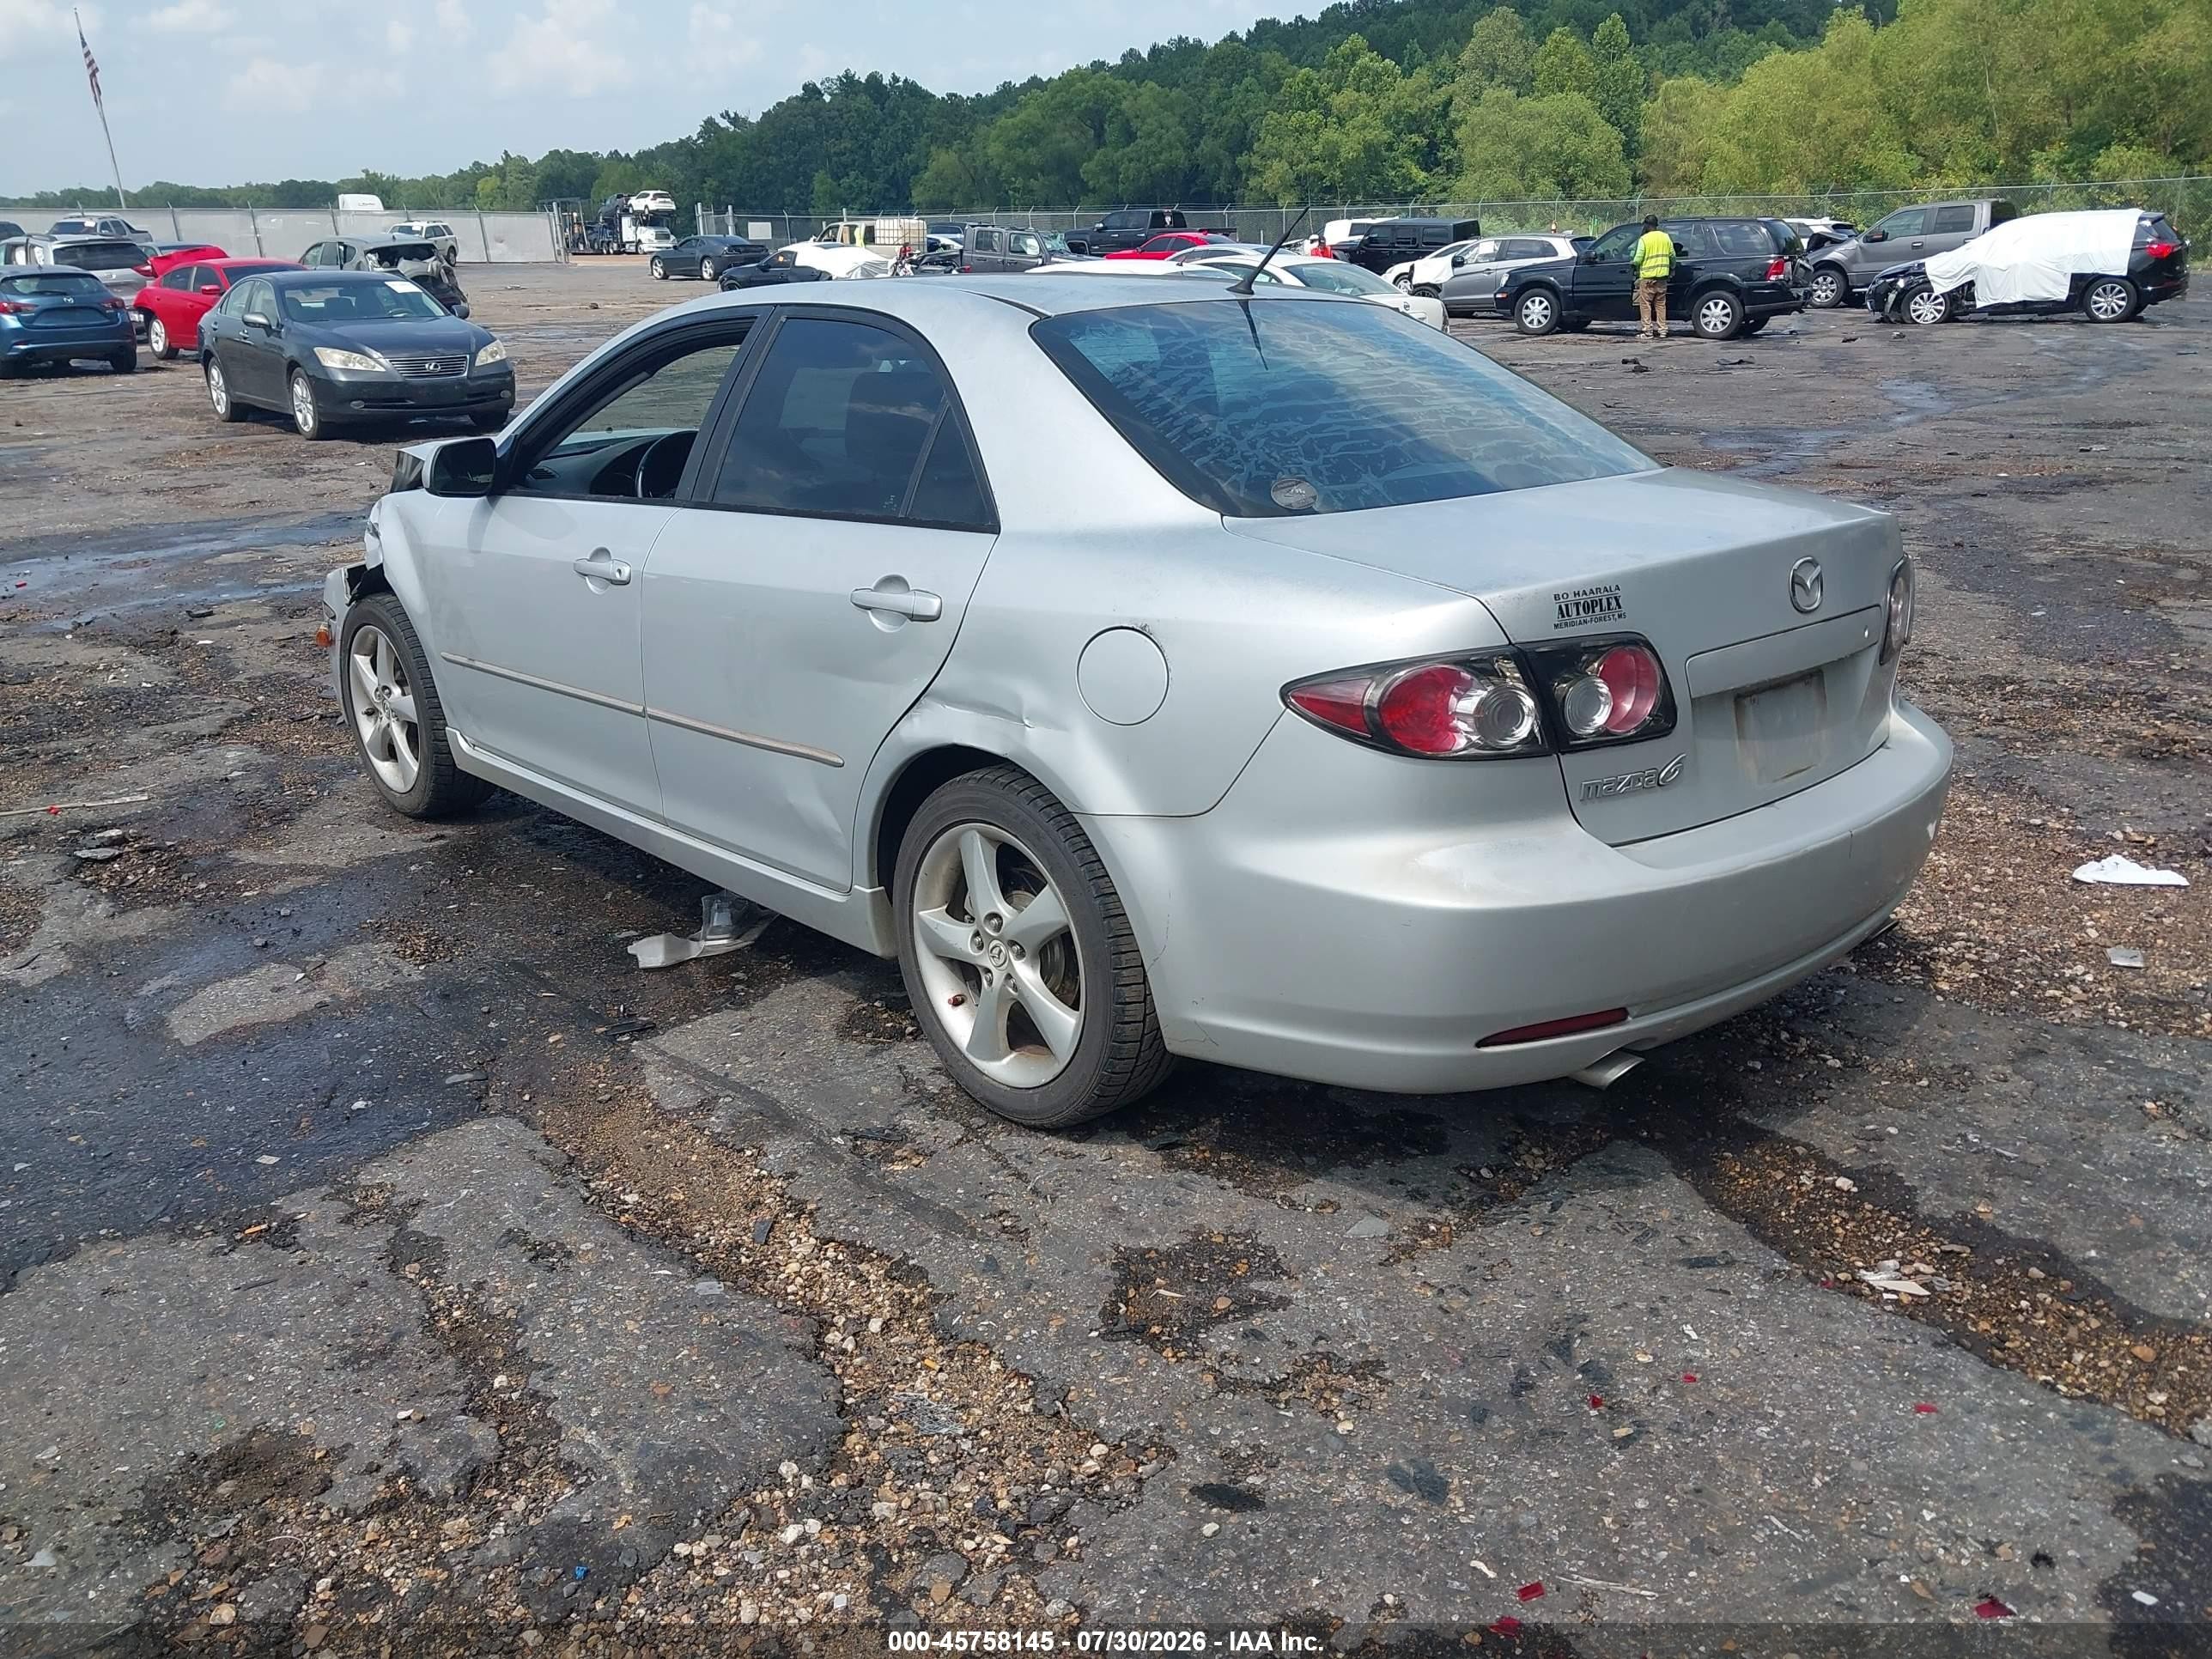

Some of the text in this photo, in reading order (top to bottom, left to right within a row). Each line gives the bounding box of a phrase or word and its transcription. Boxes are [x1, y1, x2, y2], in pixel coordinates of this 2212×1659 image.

[1553, 585, 1621, 601] BO HAARALA
[1557, 595, 1622, 619] AUTOPLEX
